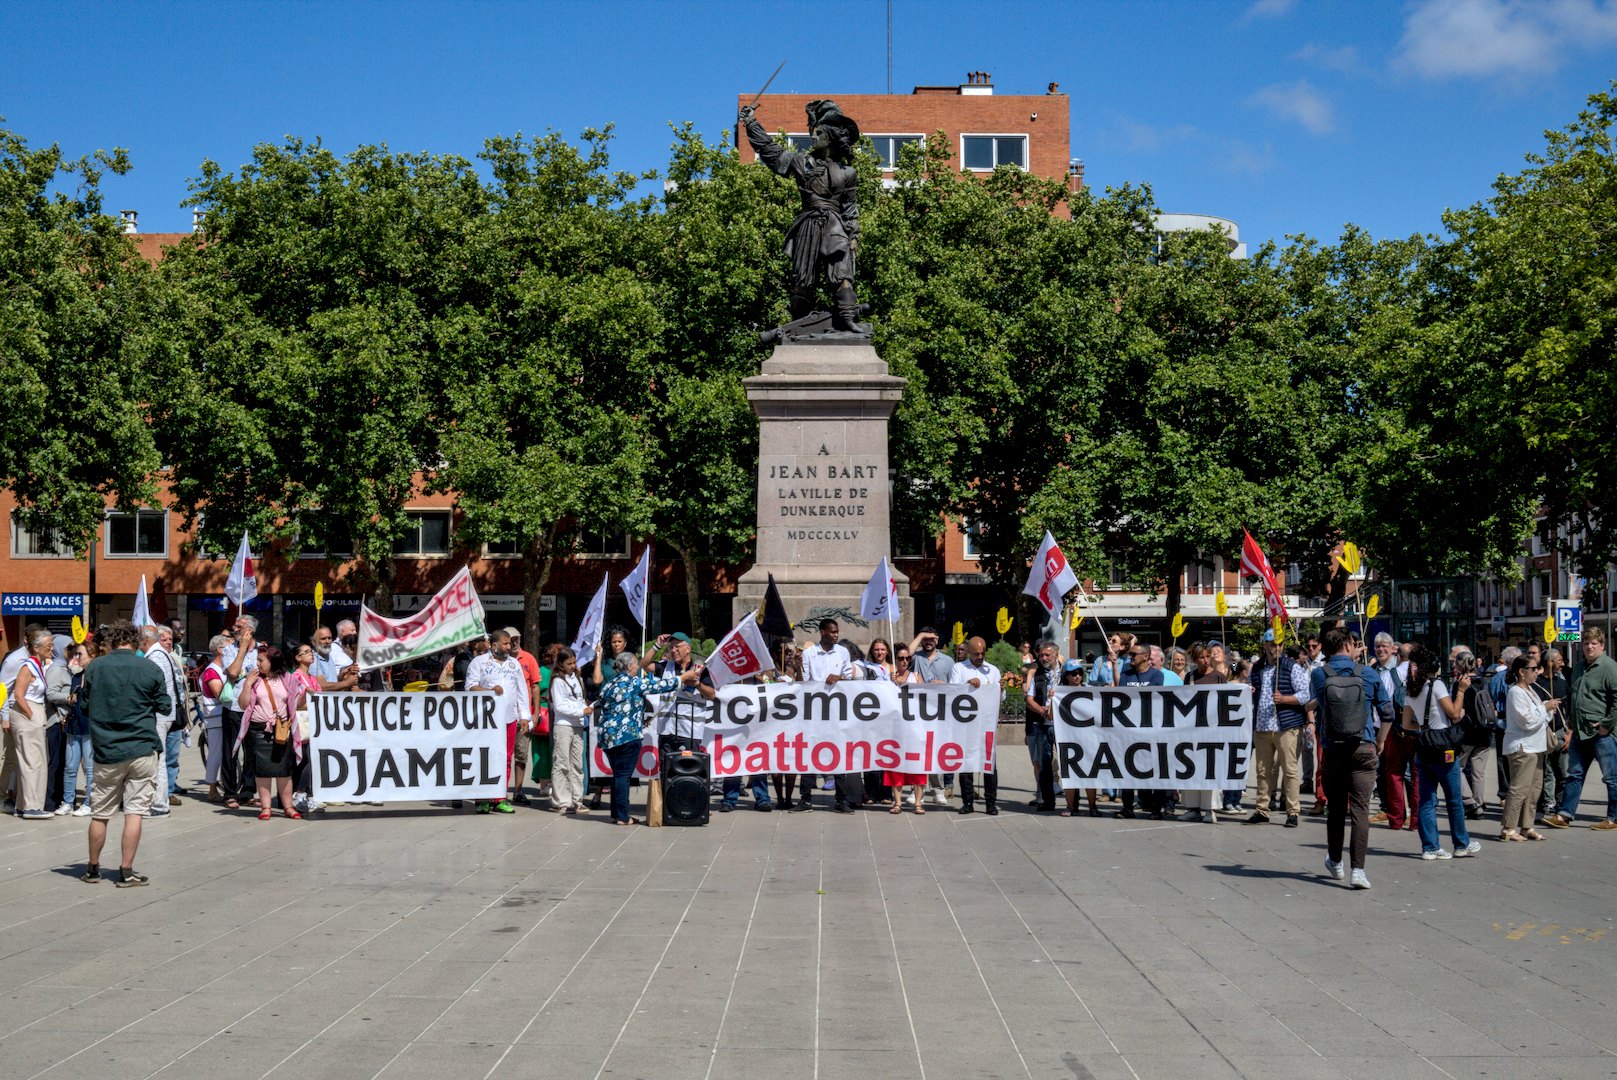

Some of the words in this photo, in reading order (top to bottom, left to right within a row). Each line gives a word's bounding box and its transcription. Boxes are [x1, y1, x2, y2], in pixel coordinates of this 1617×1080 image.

[817, 443, 830, 455] A
[770, 465, 817, 479] JEAN
[828, 465, 878, 479] BART
[778, 488, 797, 499] LA
[800, 488, 842, 499] VILLE
[849, 488, 868, 499] DE
[780, 505, 865, 517] DUNKERQUE
[787, 530, 859, 540] MDCCCXLV
[3, 595, 82, 606] ASSURANCES
[285, 599, 315, 607] BANQU
[1560, 609, 1573, 625] P
[898, 683, 979, 723] tue
[1058, 689, 1246, 729] CRIME
[311, 695, 413, 737] JUSTICE
[424, 695, 498, 730] POUR
[984, 731, 994, 772] !
[1058, 741, 1249, 780] RACISTE
[318, 747, 502, 796] DJAMEL
